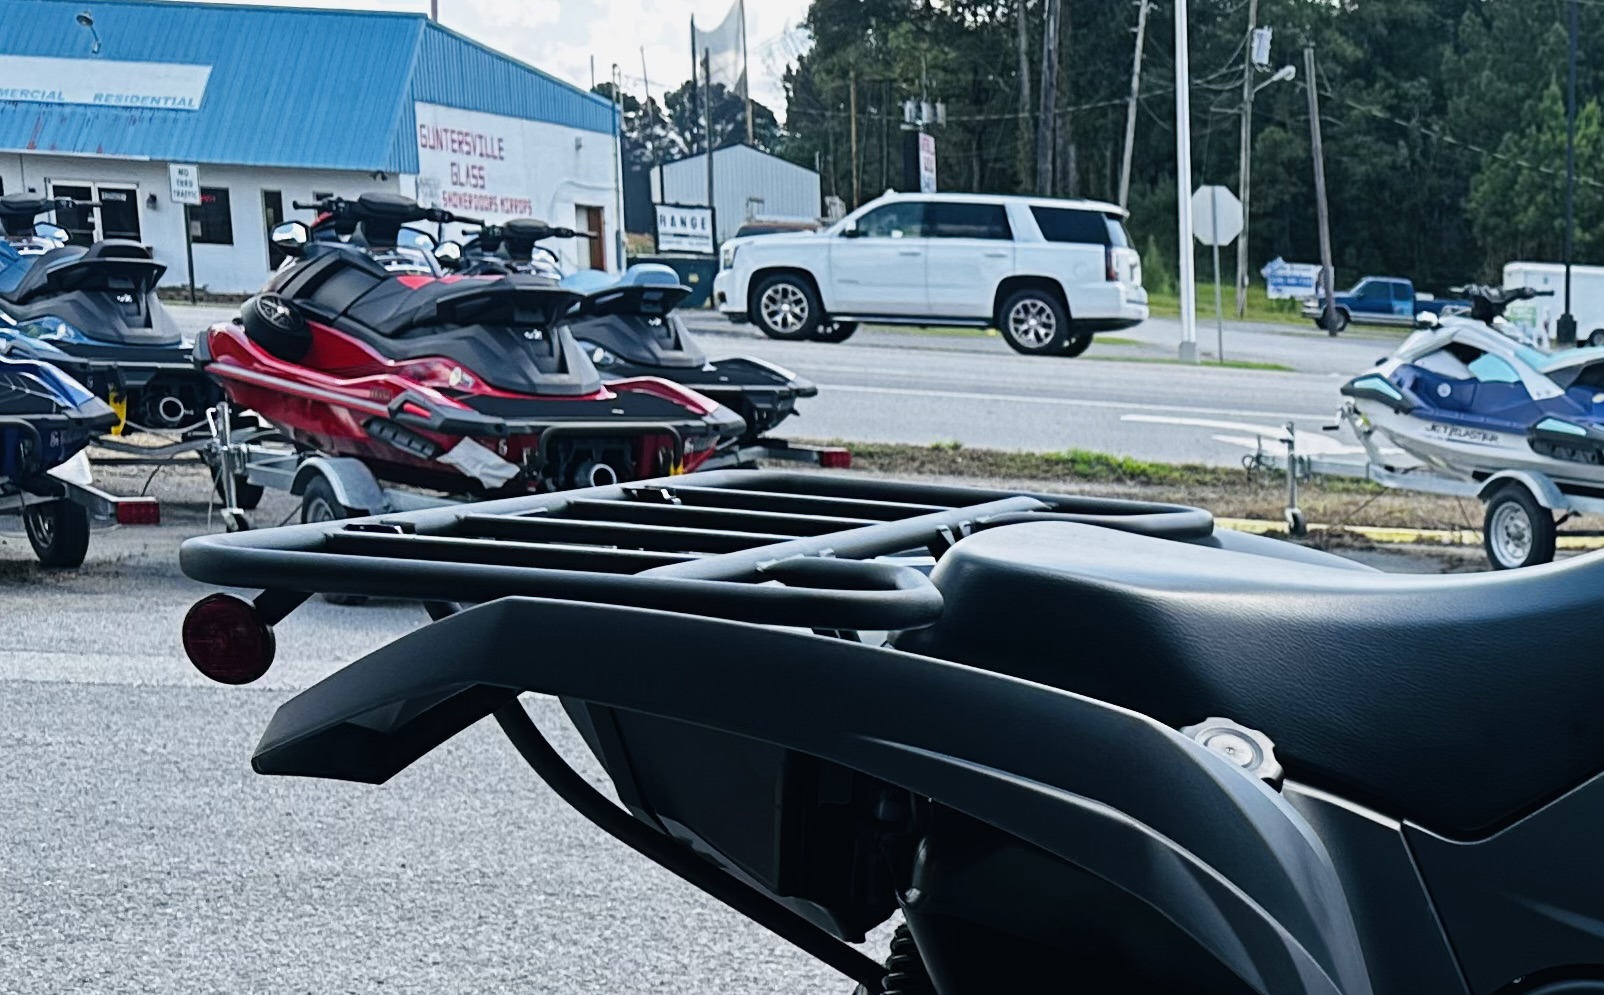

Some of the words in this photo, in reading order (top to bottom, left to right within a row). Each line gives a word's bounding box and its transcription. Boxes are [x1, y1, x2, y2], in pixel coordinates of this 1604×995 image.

[93, 92, 197, 108] RESIDENTIAL
[419, 124, 505, 161] GUNTERSVILLE
[450, 162, 486, 189] GLASS
[659, 213, 706, 230] RANGE
